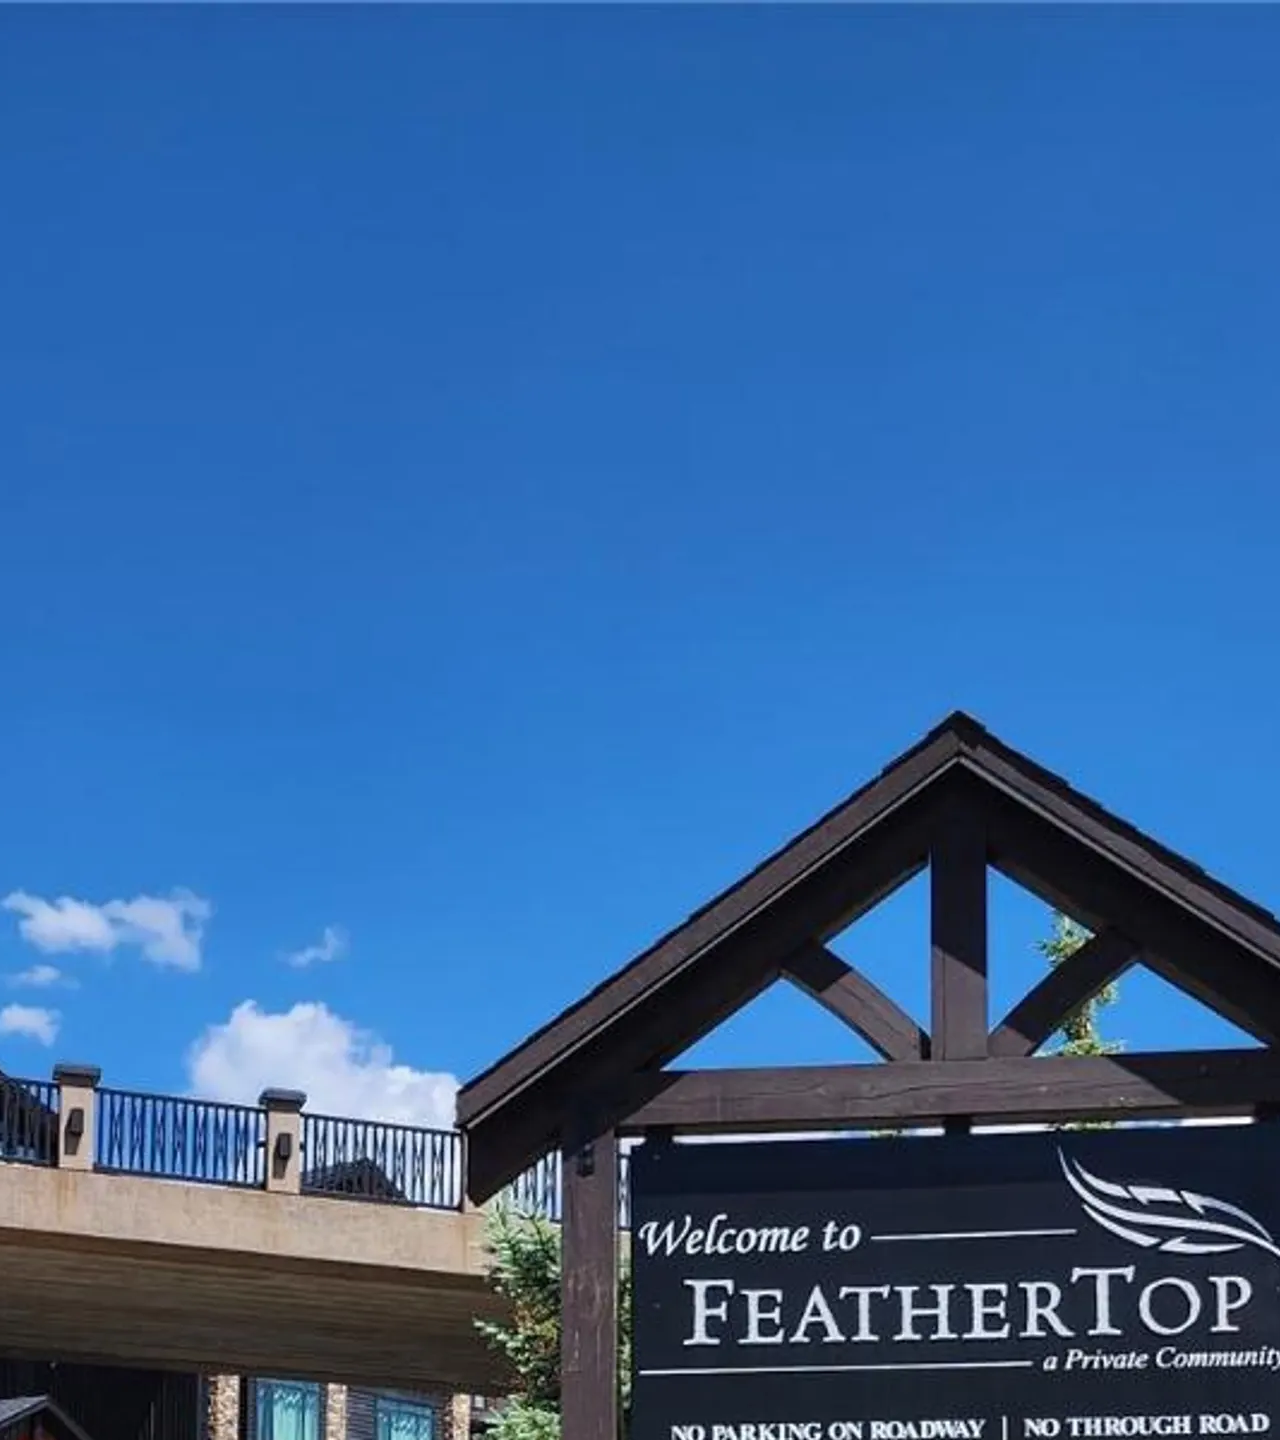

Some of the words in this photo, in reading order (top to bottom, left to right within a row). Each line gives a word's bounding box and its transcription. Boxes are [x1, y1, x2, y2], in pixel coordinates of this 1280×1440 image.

[638, 1213, 810, 1256] Welcome
[822, 1220, 862, 1251] to
[1042, 1355, 1058, 1371] a
[1064, 1348, 1149, 1371] Private
[827, 1421, 863, 1440] ON
[870, 1418, 986, 1440] ROADWAY
[1023, 1418, 1061, 1438] NO
[1065, 1415, 1192, 1437] THROUGH
[1199, 1413, 1271, 1435] ROAD
